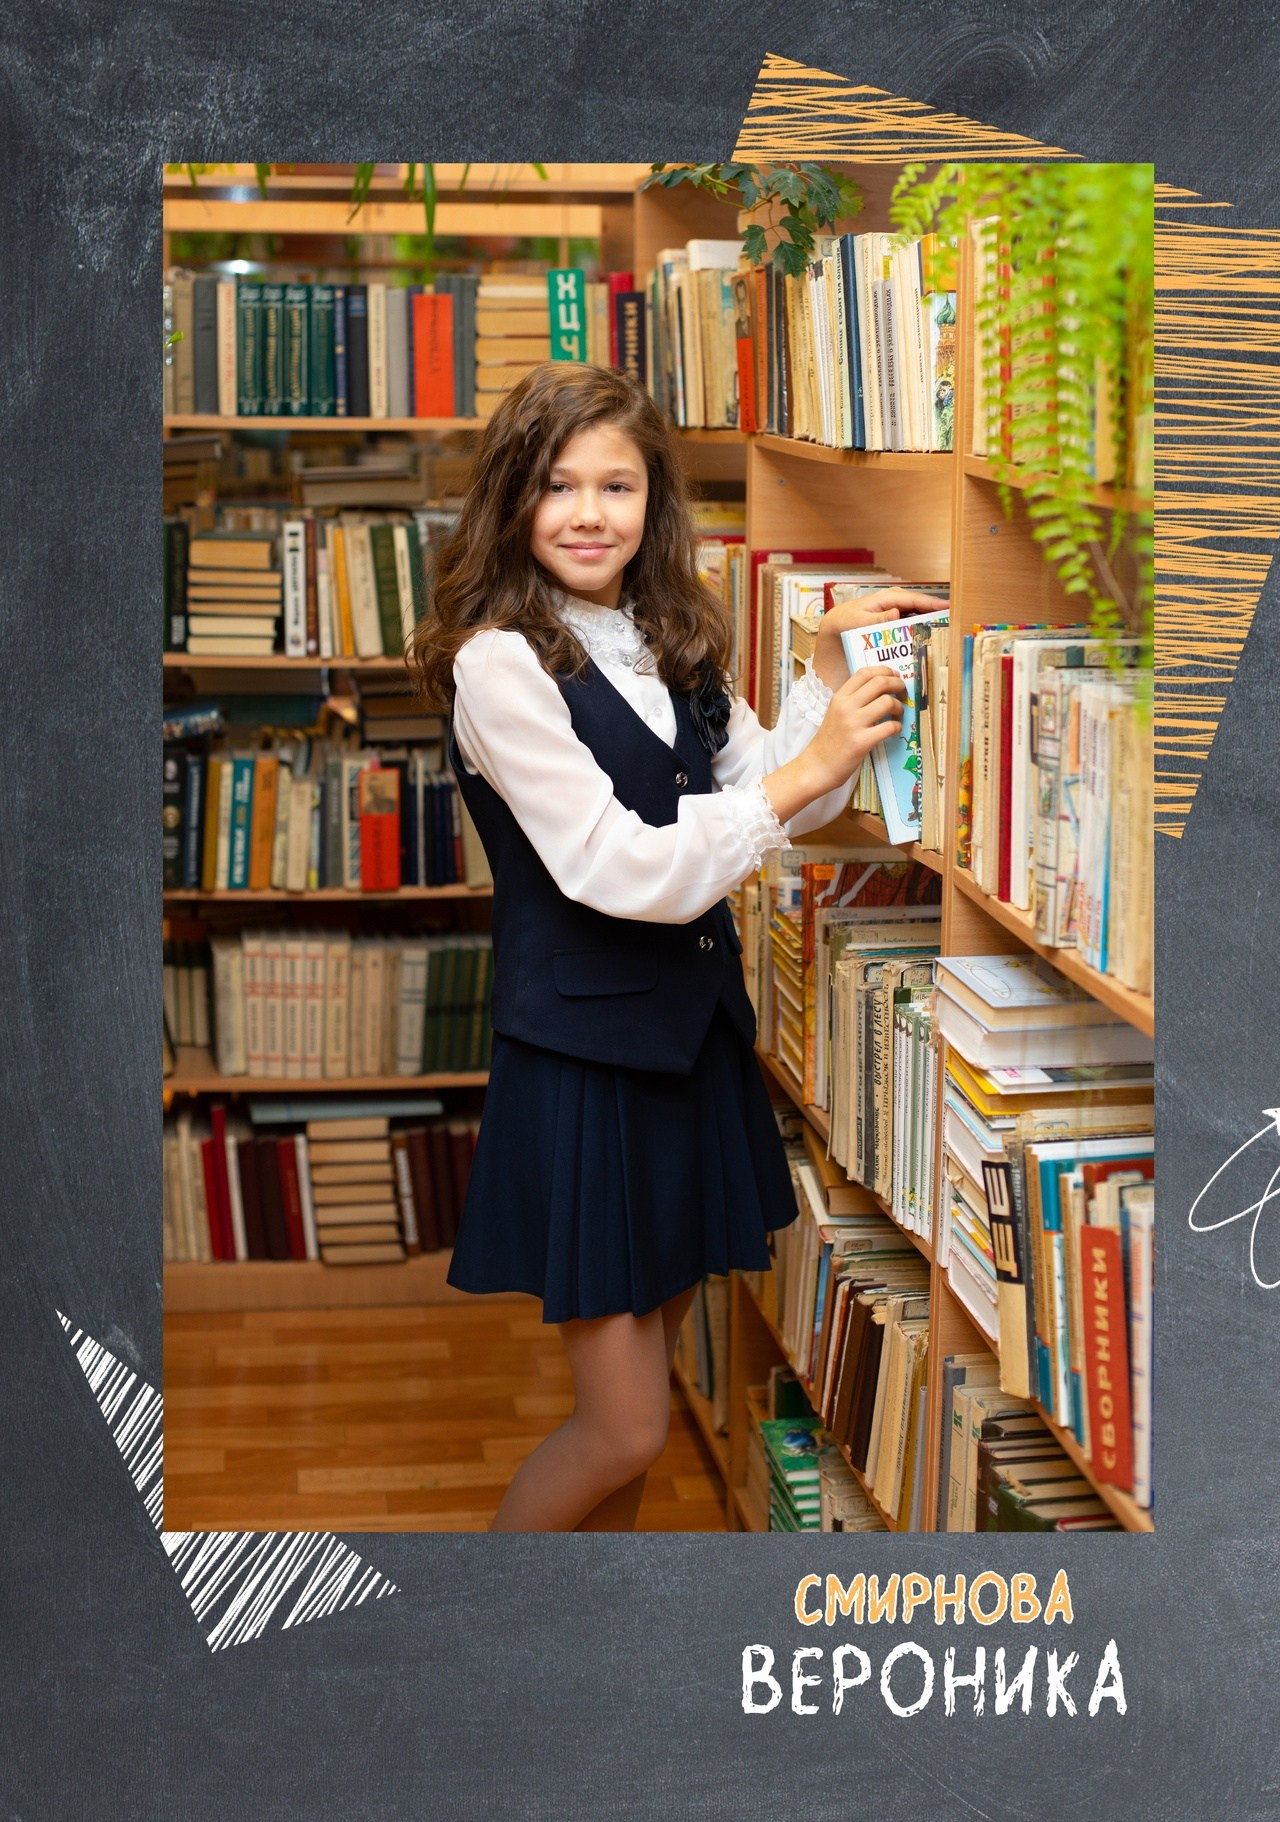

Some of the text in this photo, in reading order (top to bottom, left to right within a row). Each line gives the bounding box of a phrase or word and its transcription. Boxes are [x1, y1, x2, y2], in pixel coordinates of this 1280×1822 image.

[874, 998, 883, 1028] ЛЕСУ
[874, 1040, 882, 1086] ВЫСТРЕЛ
[1092, 1247, 1116, 1470] СБОРНИКИ
